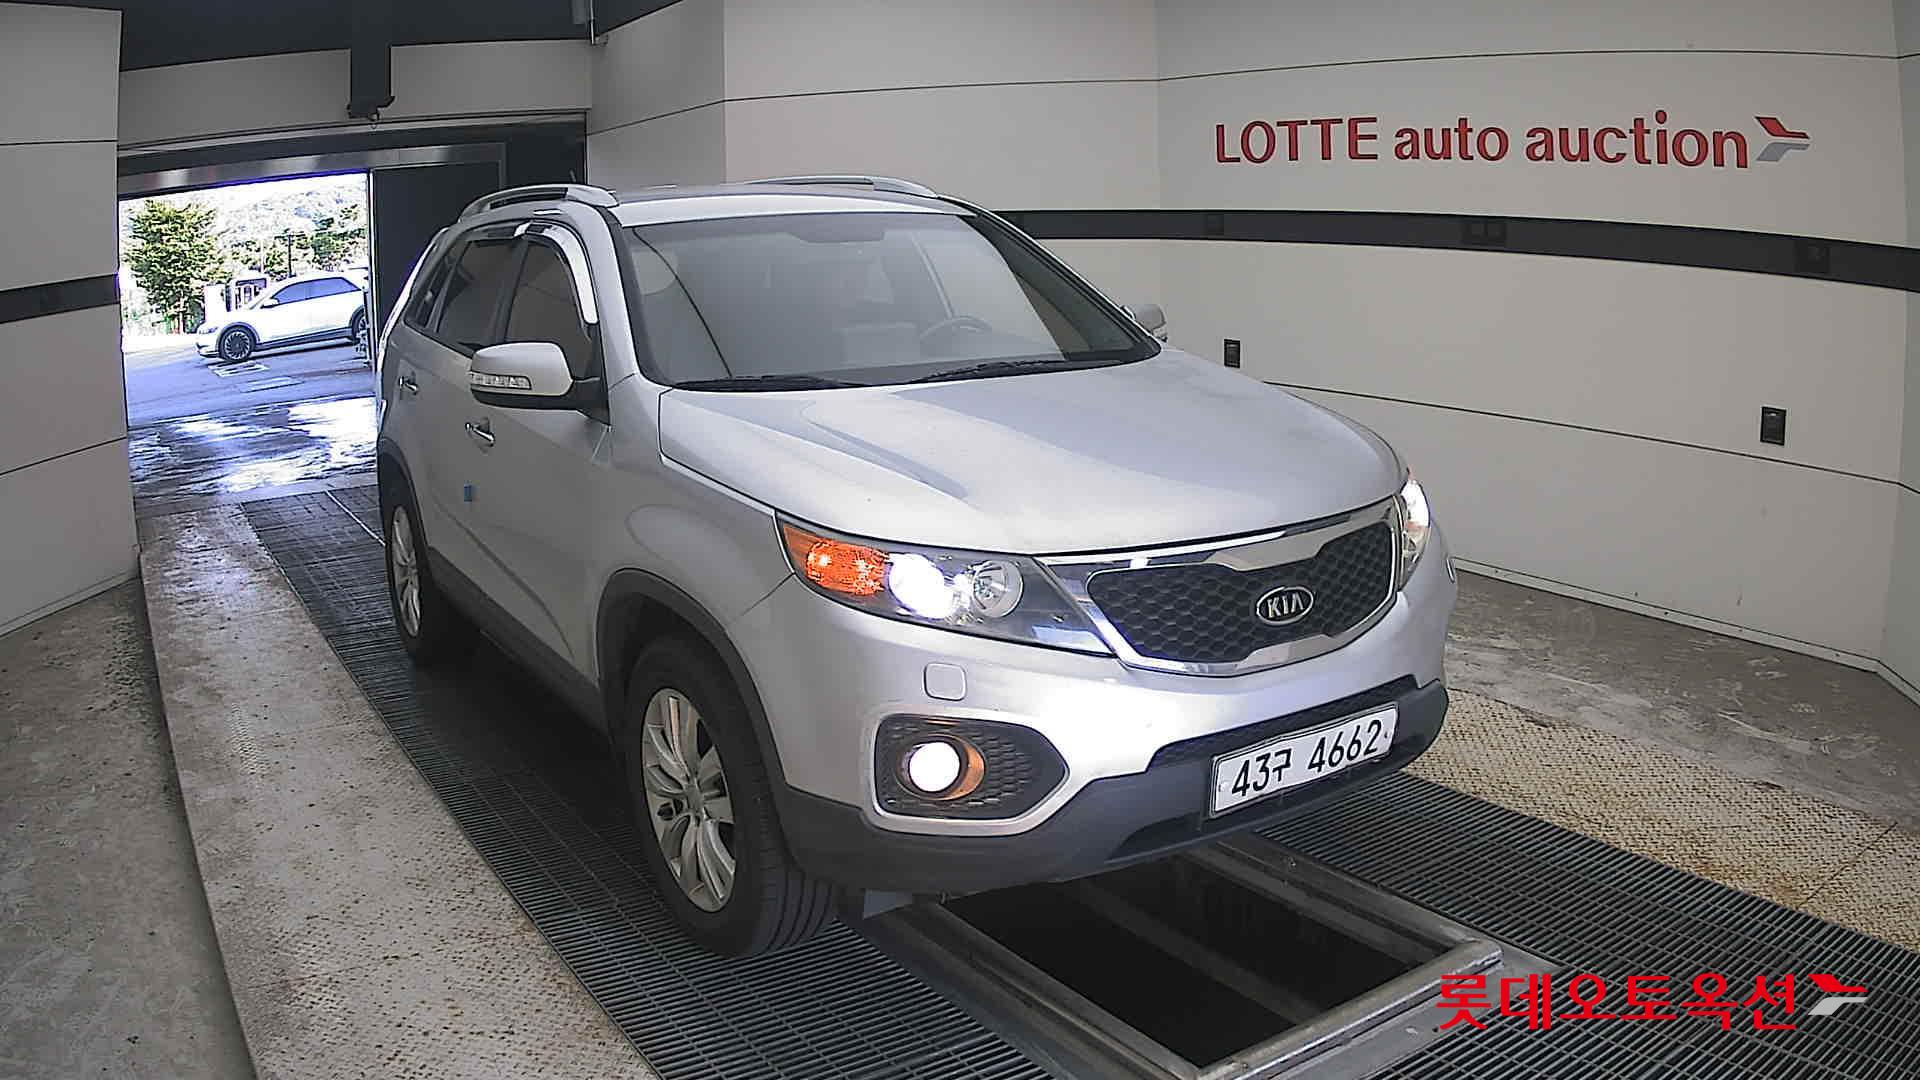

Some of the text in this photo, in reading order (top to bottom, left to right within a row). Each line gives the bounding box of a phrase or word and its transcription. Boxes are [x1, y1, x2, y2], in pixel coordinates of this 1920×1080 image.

[1215, 110, 1749, 168] LOTTE auto auction
[1266, 592, 1305, 618] KIA
[1307, 719, 1383, 773] 4662
